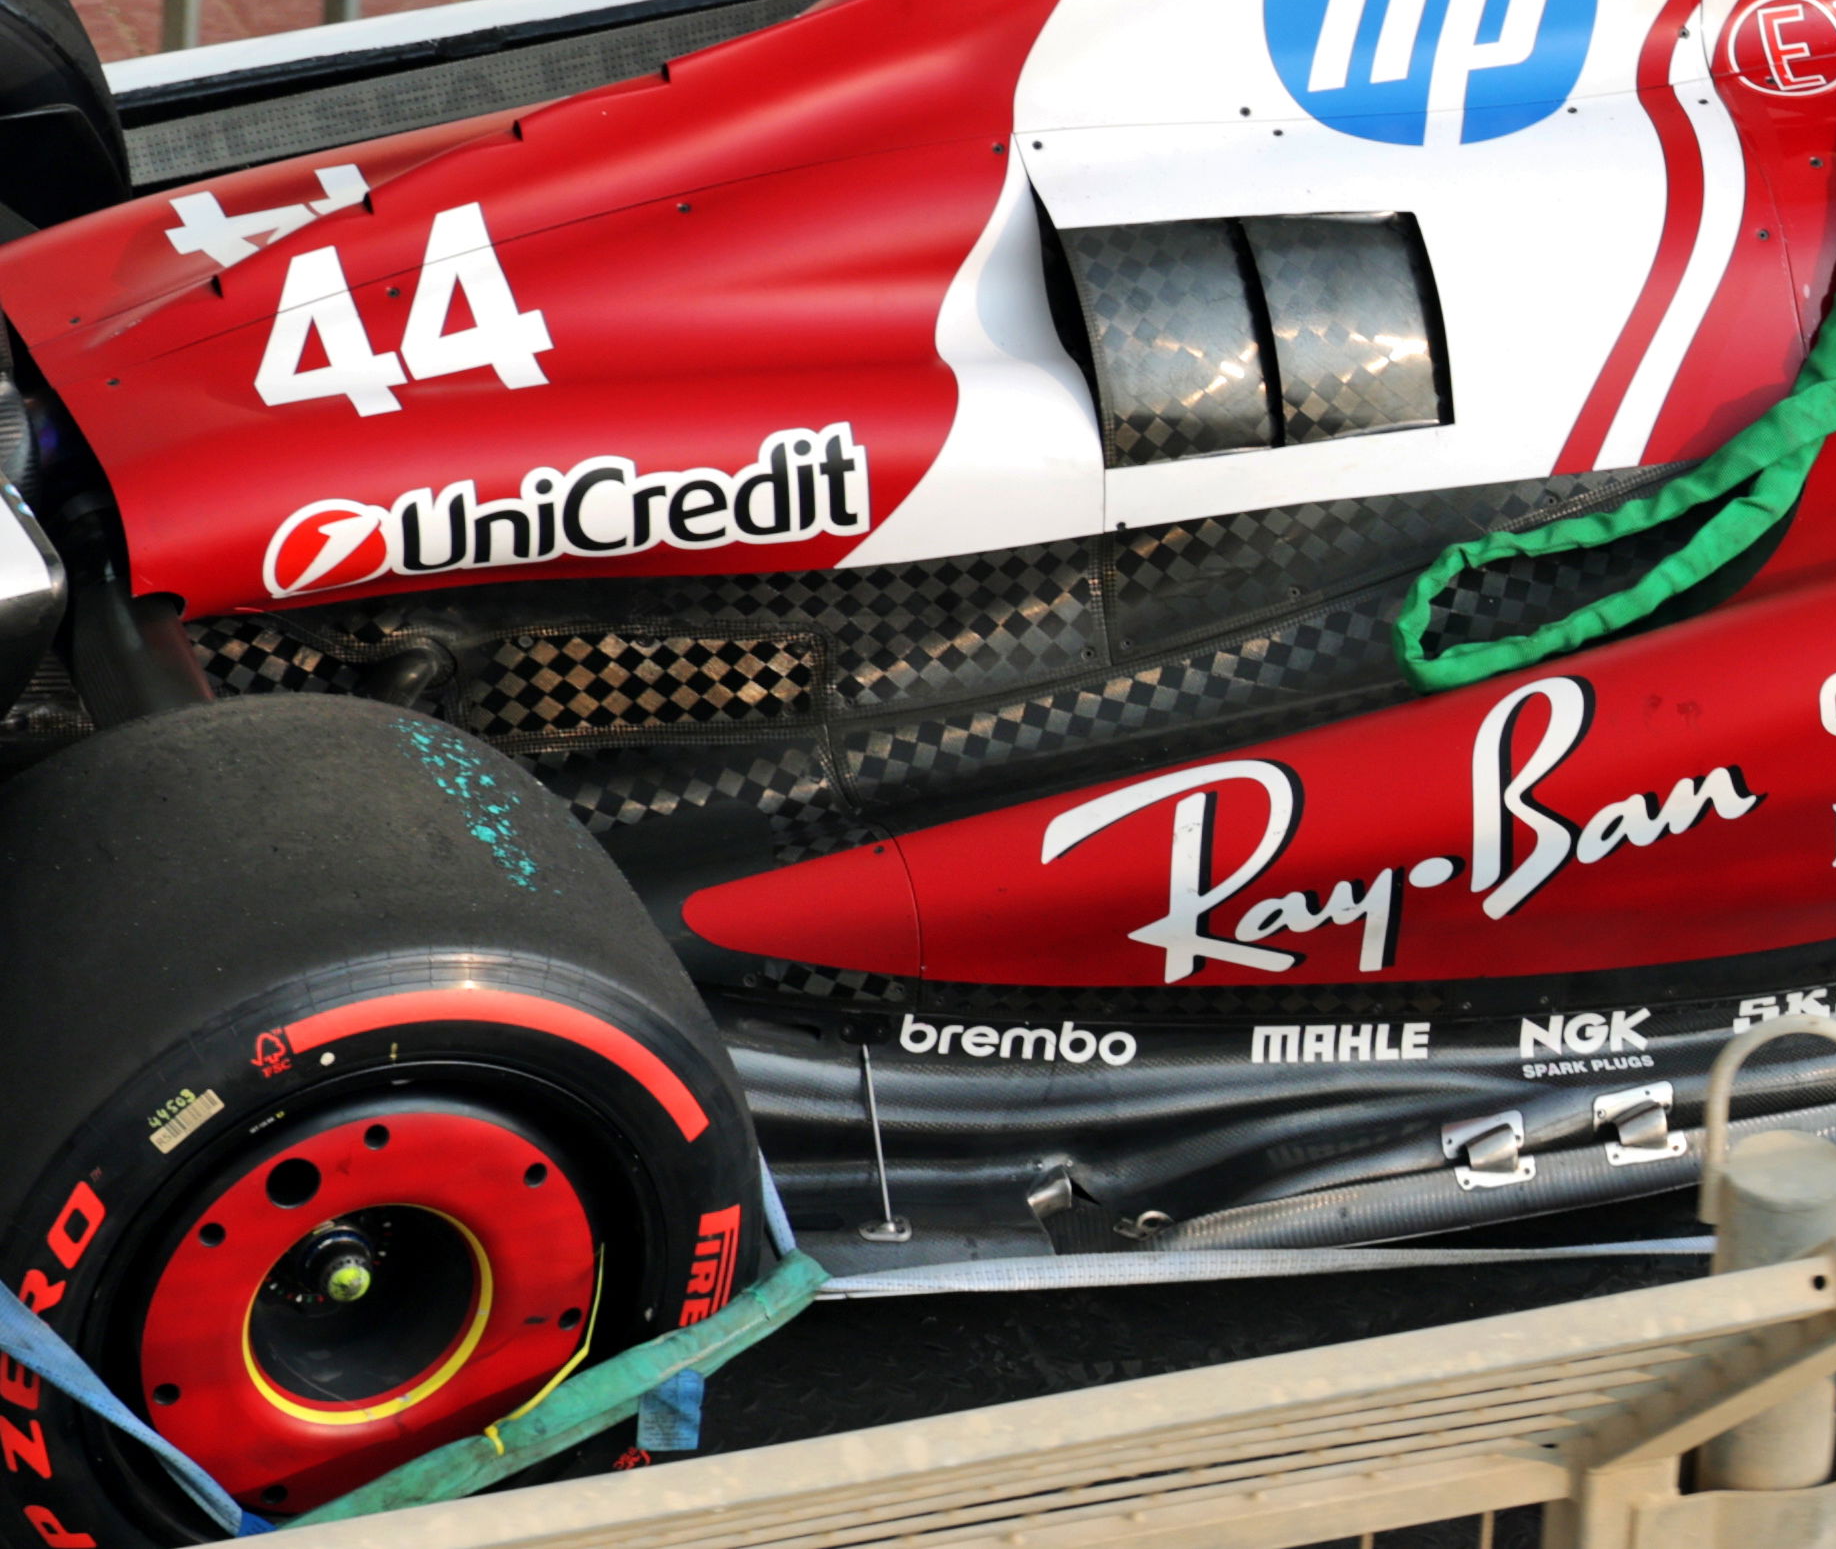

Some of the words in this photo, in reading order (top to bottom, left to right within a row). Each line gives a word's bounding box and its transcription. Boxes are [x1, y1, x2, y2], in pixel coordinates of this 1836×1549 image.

[254, 202, 554, 417] 44
[400, 434, 859, 576] UniCredit
[899, 1015, 1138, 1066] brembo
[1250, 1022, 1430, 1064] MAHLE
[1519, 1007, 1651, 1059] NGK
[1522, 1060, 1588, 1079] SPARK
[1591, 1055, 1655, 1072] PLUGS
[679, 1204, 741, 1327] PIRE
